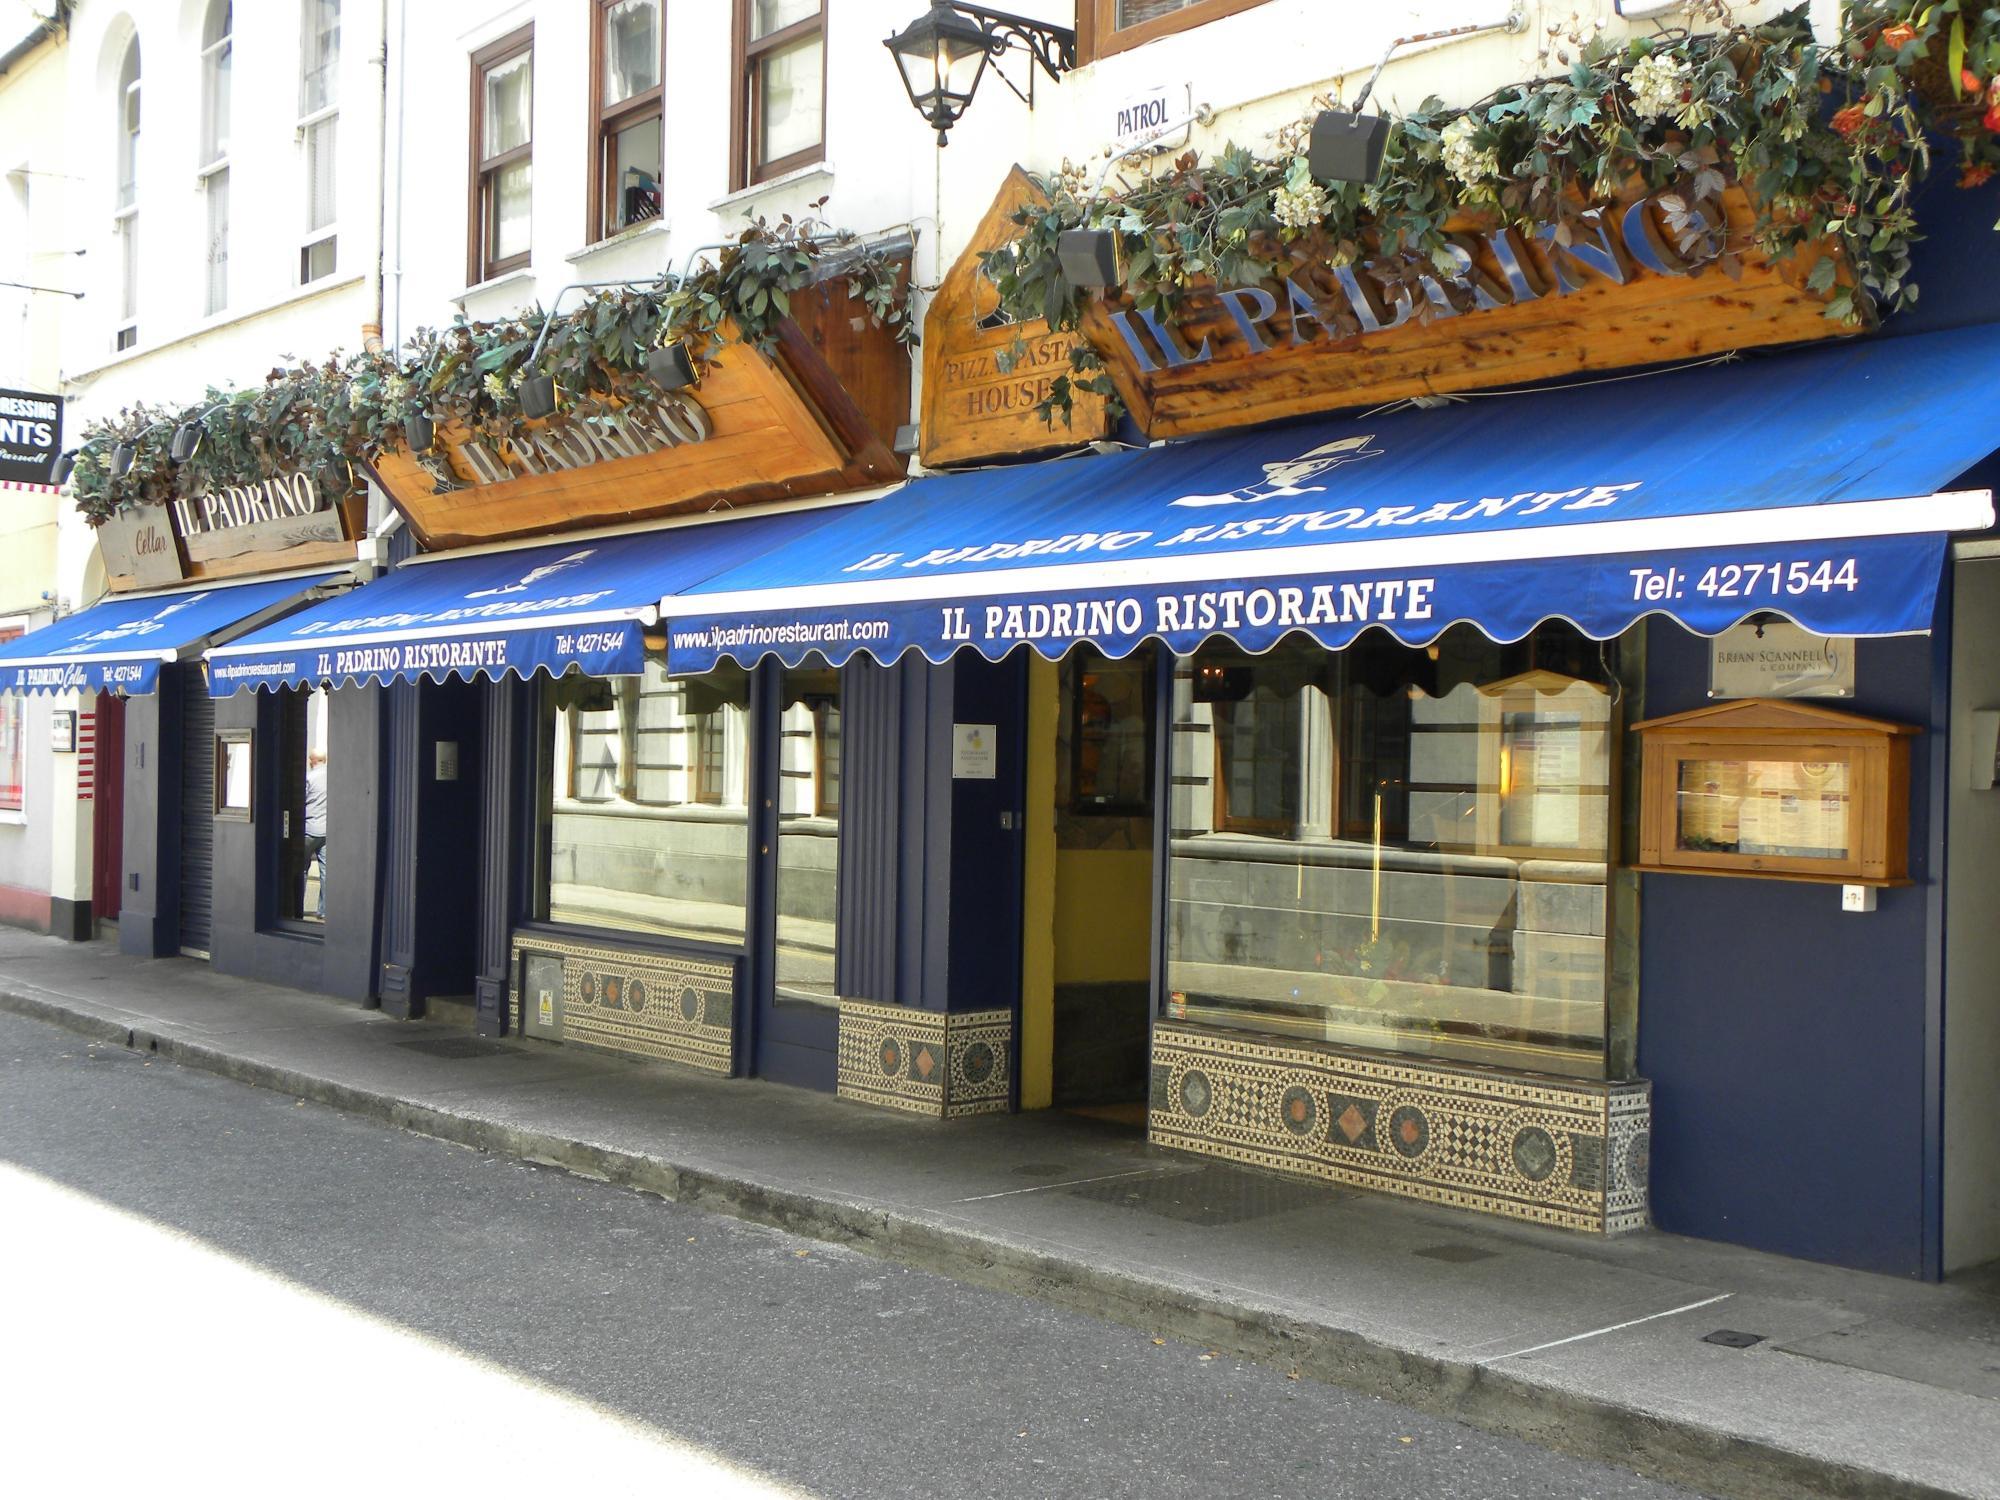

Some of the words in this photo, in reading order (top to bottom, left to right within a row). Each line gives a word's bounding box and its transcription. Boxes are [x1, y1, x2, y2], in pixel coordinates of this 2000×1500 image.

[1117, 97, 1169, 137] PATROL
[1109, 303, 1213, 373] IL
[968, 377, 1051, 417] HOUSE
[458, 442, 518, 486] IL
[173, 498, 201, 538] IL
[202, 471, 315, 532] PADRINO
[135, 525, 168, 556] Cellar
[672, 619, 889, 652] www.ilpadrinorestaurant.com
[941, 608, 971, 641] IL
[984, 598, 1143, 640] PADRINO
[1156, 578, 1436, 633] RISTORANTE
[1629, 567, 1687, 601] Tel:
[1696, 558, 1859, 598] 4271544
[317, 655, 331, 676] IL
[336, 644, 401, 676] PADRINO
[403, 639, 507, 670] RISTORANTE
[555, 635, 577, 655] Tel:
[576, 631, 625, 653] 4271544
[1718, 651, 1755, 664] BRIAN
[1759, 650, 1824, 662] SCANNELL
[27, 667, 65, 686] PADRINO
